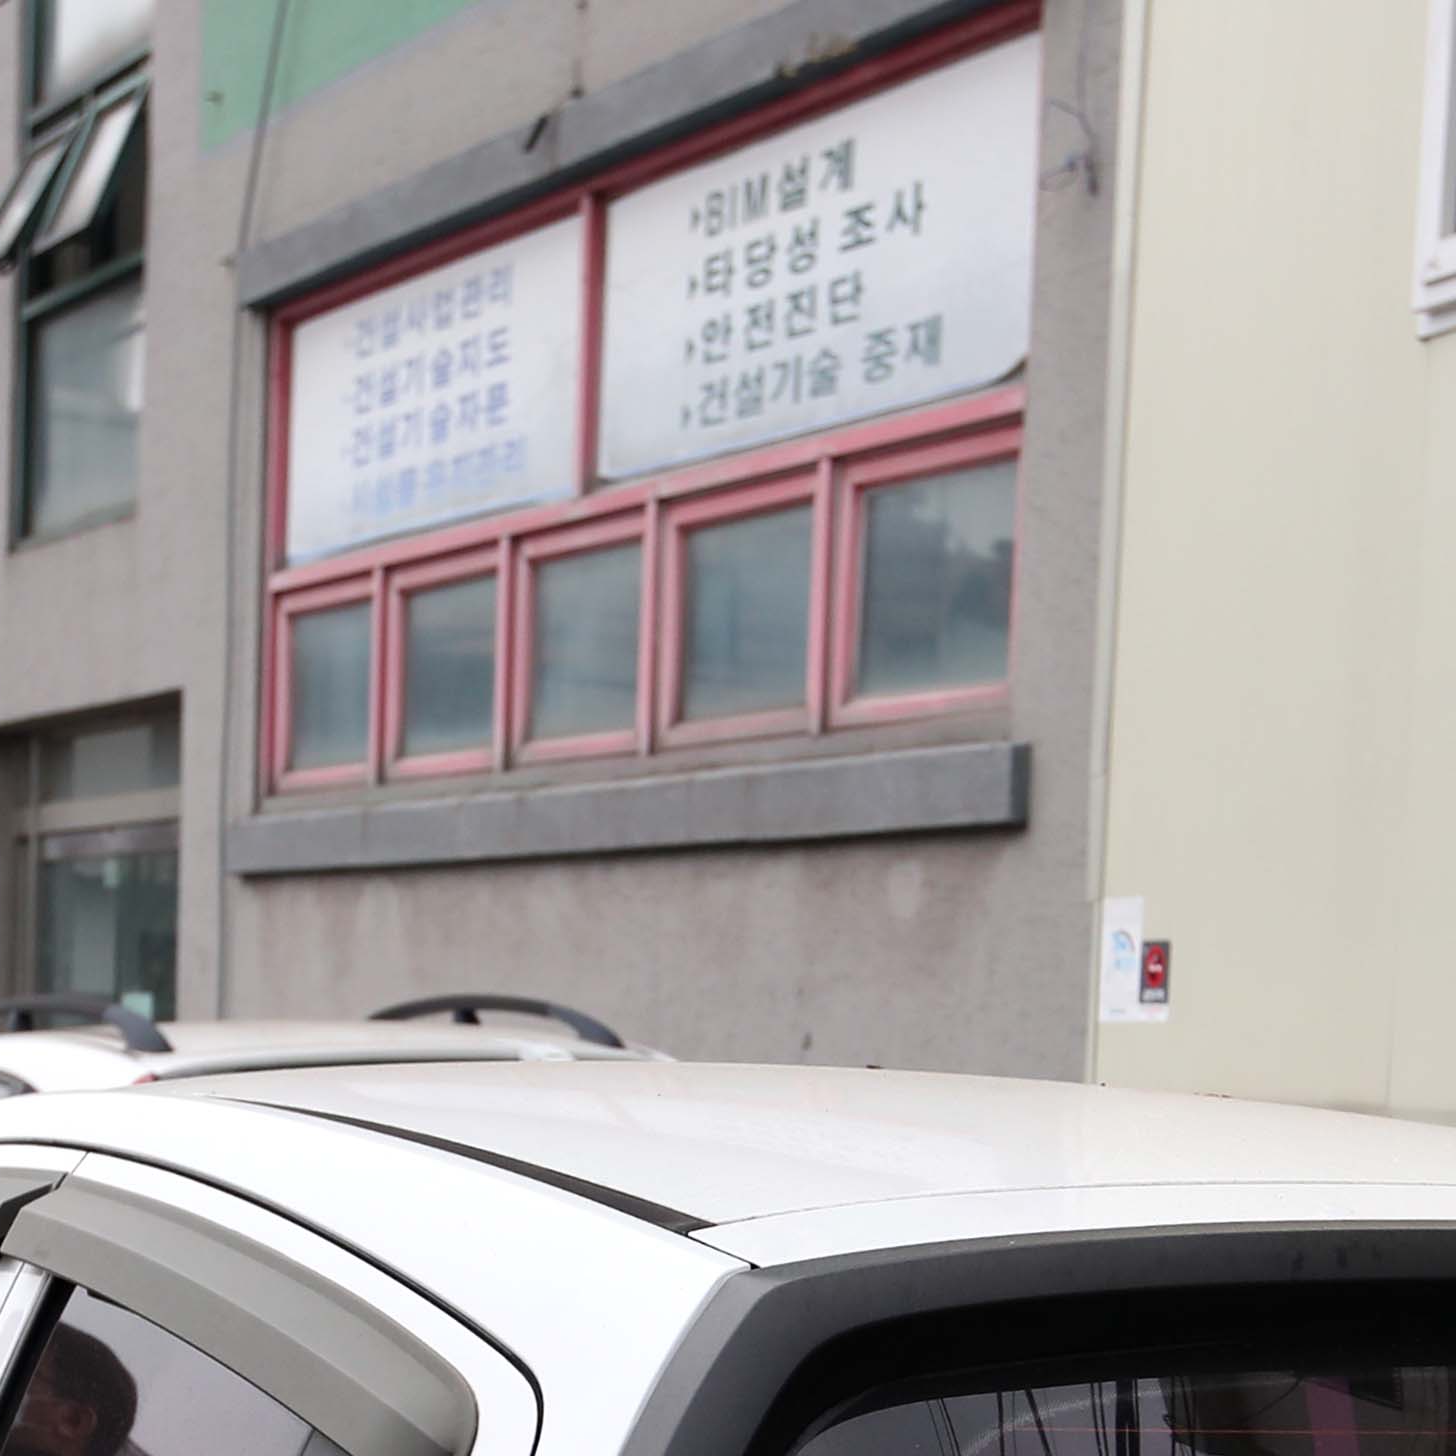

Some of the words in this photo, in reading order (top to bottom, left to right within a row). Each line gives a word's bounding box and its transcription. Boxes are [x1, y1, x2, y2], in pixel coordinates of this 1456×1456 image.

[704, 217, 820, 294] 타당성
[840, 180, 926, 252] 조사
[705, 137, 856, 237] BIM설계
[698, 348, 842, 427] 건설기술
[862, 313, 943, 384] 중재
[701, 270, 863, 364] 안전진단
